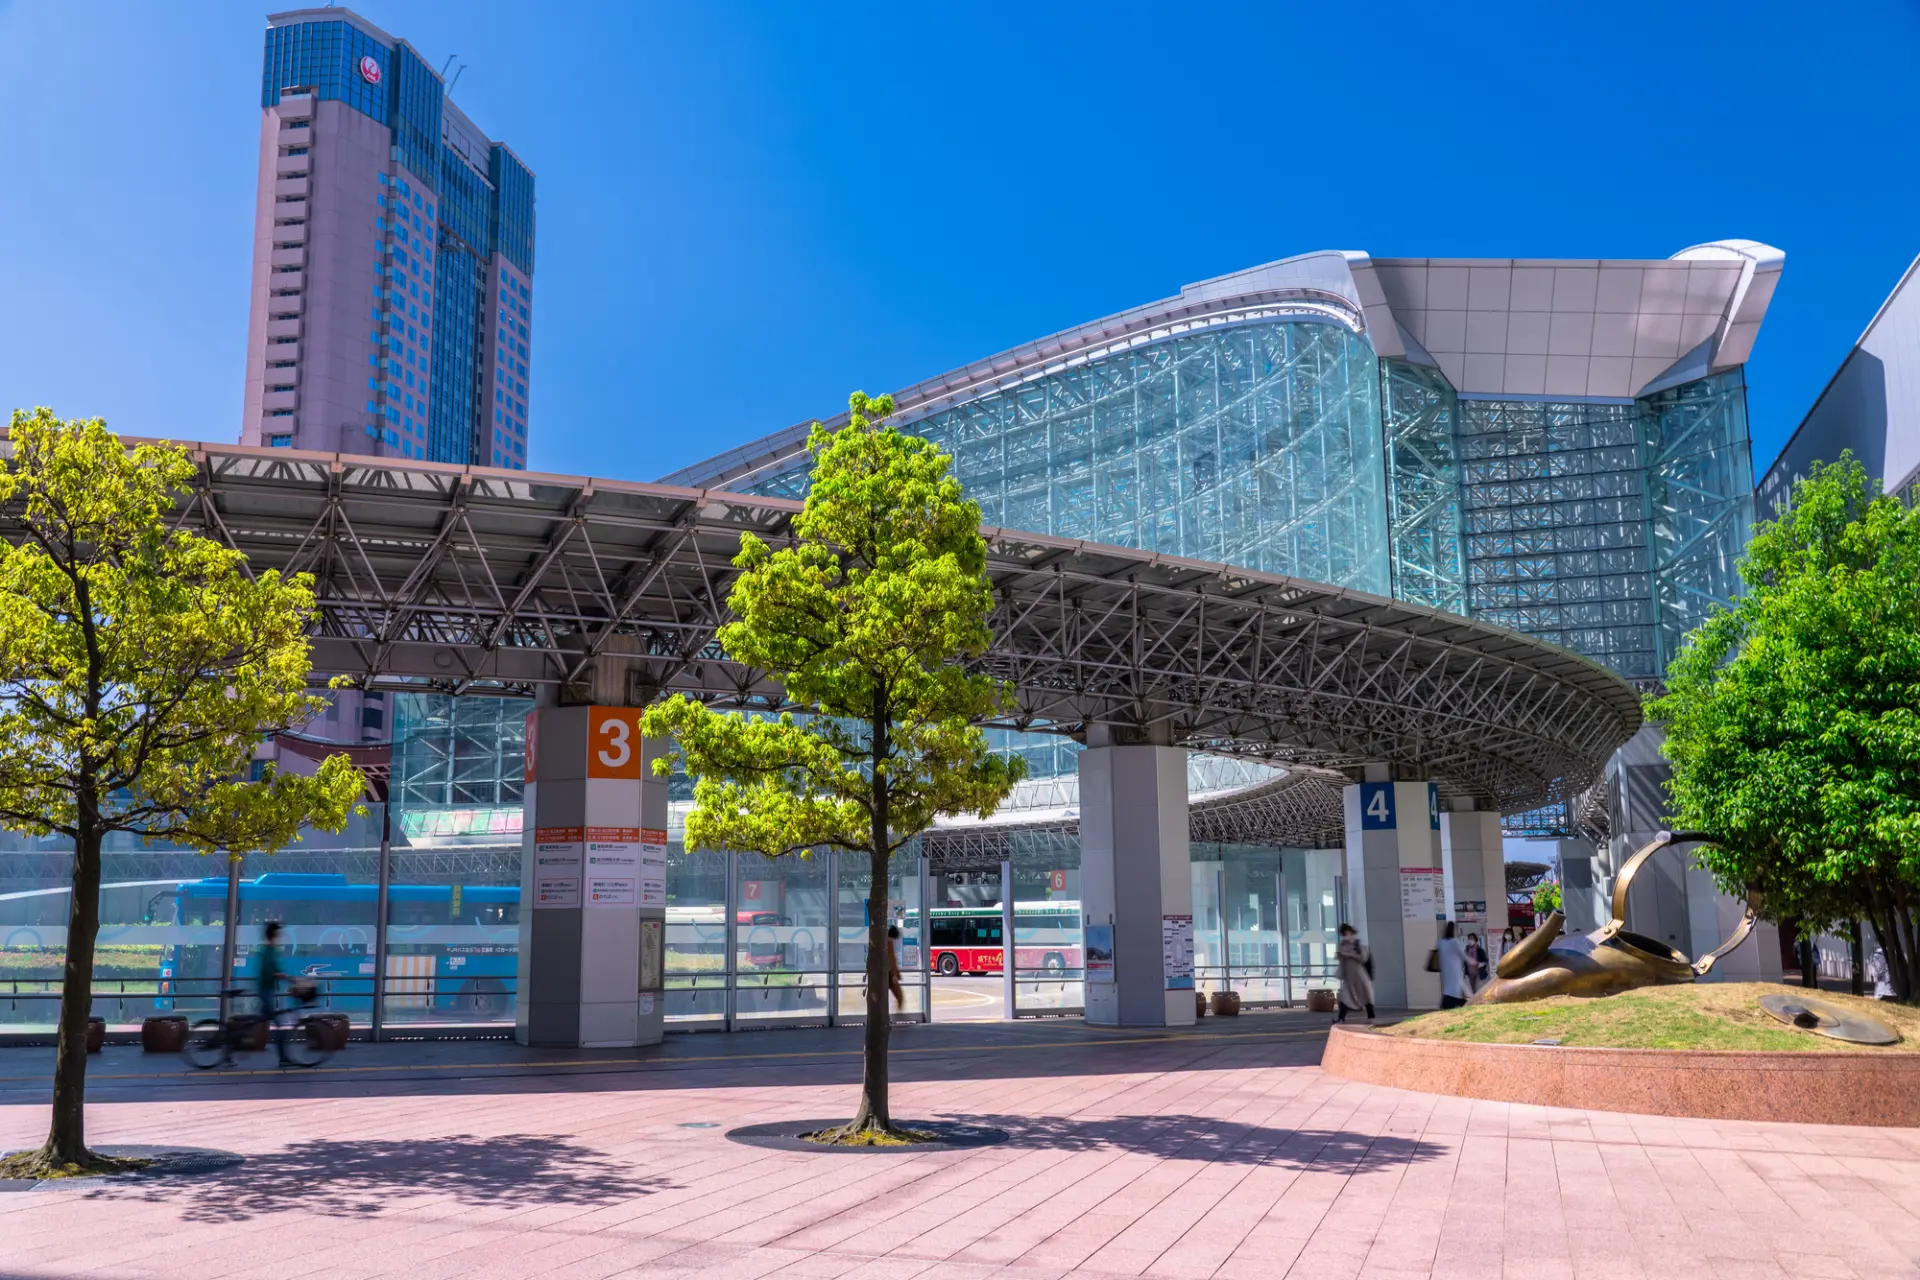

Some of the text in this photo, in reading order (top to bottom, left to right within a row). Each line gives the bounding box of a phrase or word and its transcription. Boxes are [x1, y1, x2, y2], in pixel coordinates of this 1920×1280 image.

[527, 724, 535, 771] 3
[598, 718, 631, 768] 3
[1367, 790, 1390, 822] 4
[1430, 791, 1438, 823] 4
[748, 884, 756, 898] 7
[1055, 873, 1062, 888] 6
